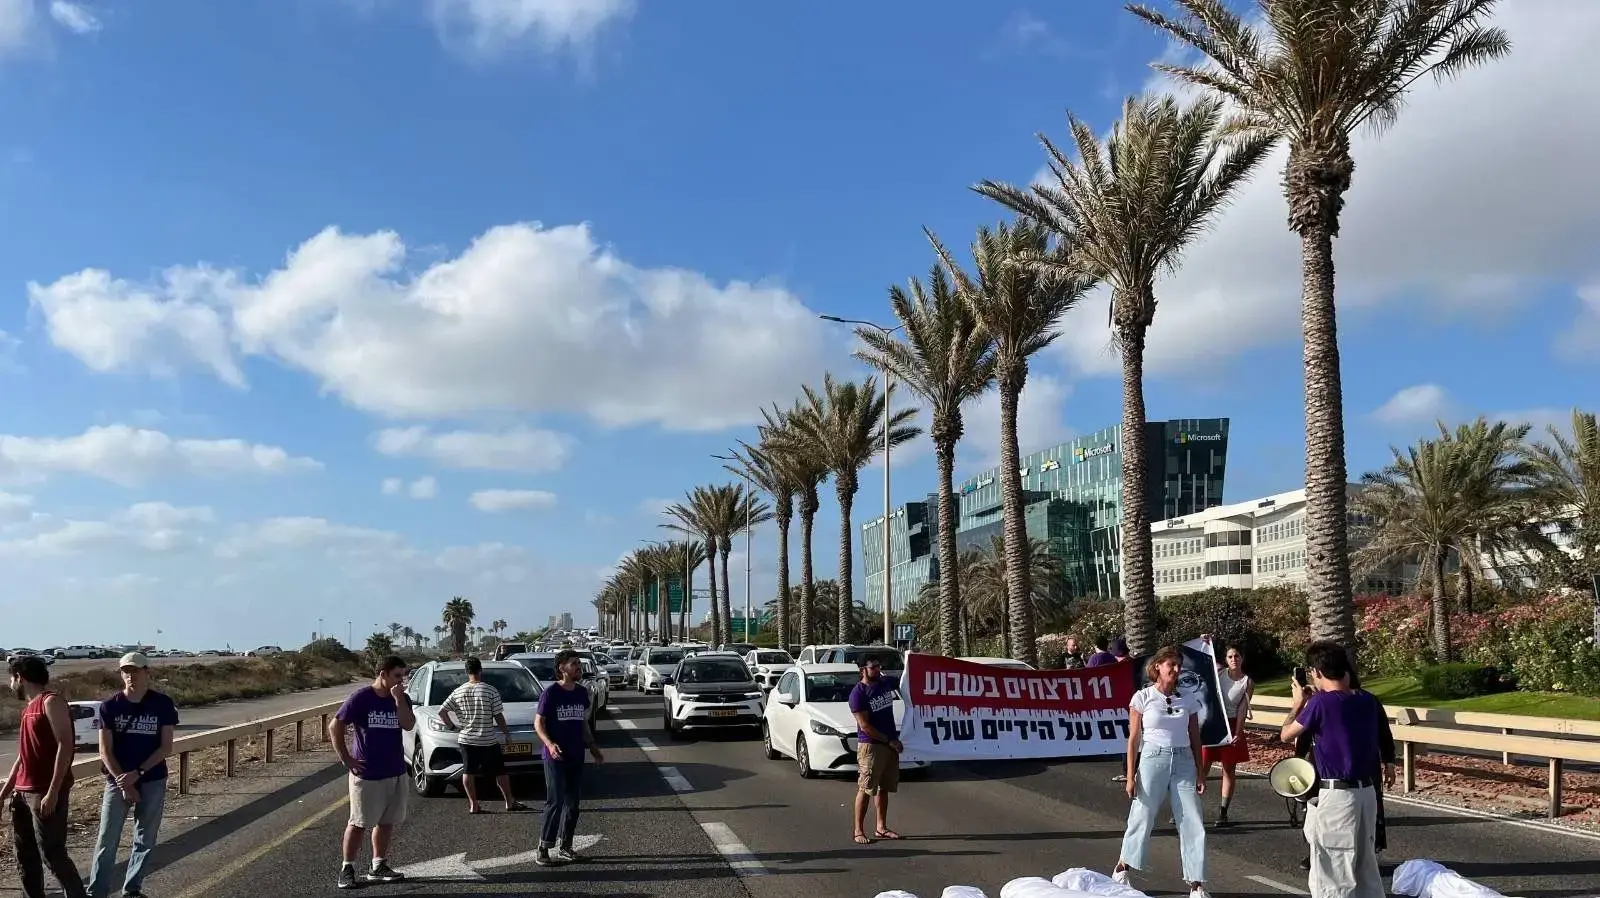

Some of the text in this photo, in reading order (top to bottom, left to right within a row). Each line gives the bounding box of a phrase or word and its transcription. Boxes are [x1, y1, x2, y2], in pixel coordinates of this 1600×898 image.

[1188, 431, 1221, 442] Microsoft
[1084, 443, 1113, 459] Microsoft
[923, 671, 1113, 700] 11 נרצחים בשבוע
[923, 717, 975, 745] שלך
[981, 719, 1056, 741] הידיים
[1058, 717, 1093, 741] על
